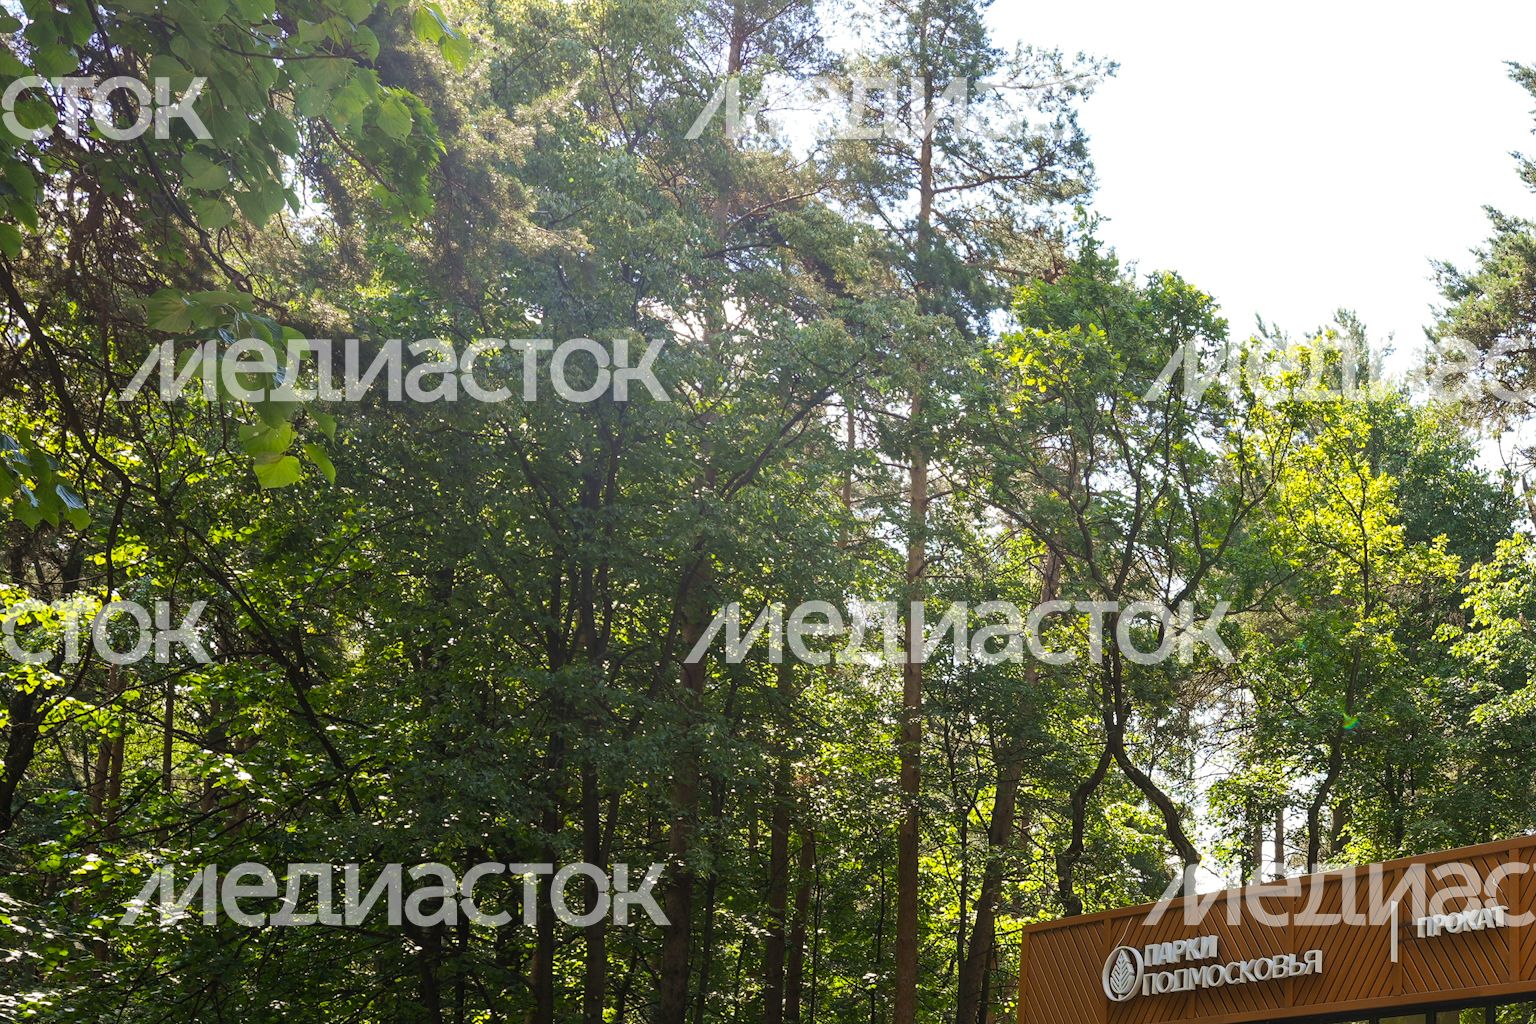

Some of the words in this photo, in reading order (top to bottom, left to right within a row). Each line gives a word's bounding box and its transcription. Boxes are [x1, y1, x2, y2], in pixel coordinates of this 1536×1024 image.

[1417, 905, 1509, 938] ПРОКАТ
[1143, 935, 1218, 967] ПАРКИ
[1142, 949, 1323, 996] ПОДМОСКОВЬЯ
